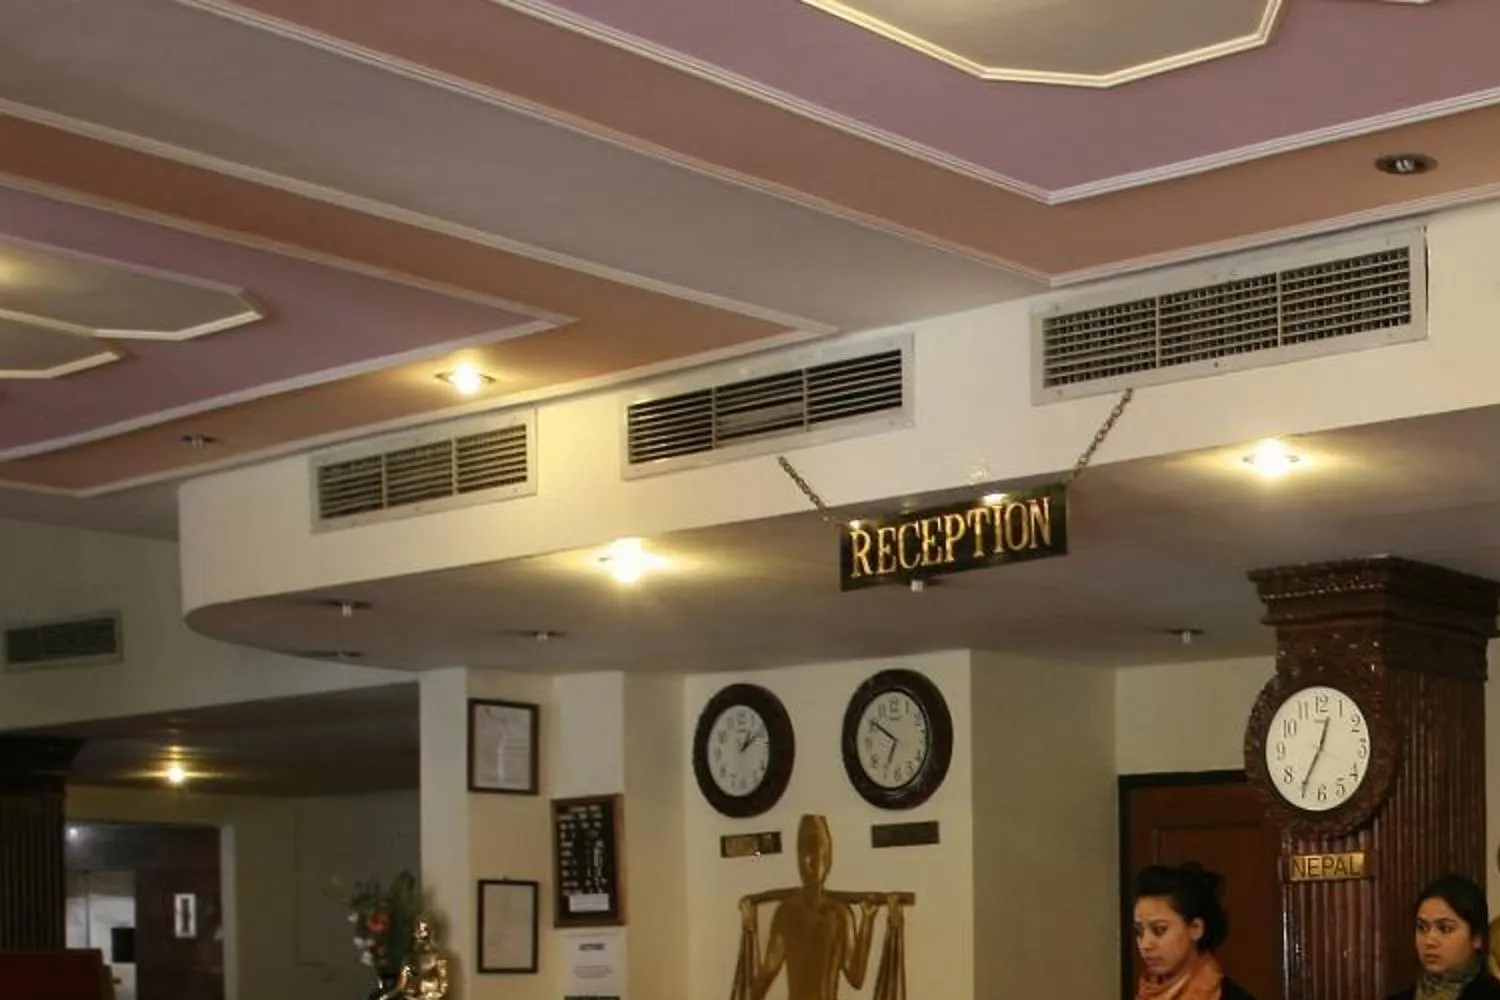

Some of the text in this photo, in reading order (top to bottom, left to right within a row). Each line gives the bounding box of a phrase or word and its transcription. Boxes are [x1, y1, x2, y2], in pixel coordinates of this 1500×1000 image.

[850, 496, 1052, 577] RECEPTION
[1298, 701, 1309, 720] 11
[1315, 695, 1329, 713] 12
[1338, 699, 1343, 718] 1
[1283, 719, 1297, 738] 10
[1351, 714, 1361, 733] 2
[1276, 742, 1286, 761] 9
[1359, 738, 1369, 758] 3
[1283, 766, 1294, 784] 8
[1350, 762, 1359, 782] 4
[1317, 784, 1328, 802] 6
[1335, 777, 1346, 797] 5
[1292, 855, 1361, 878] NEPAL
